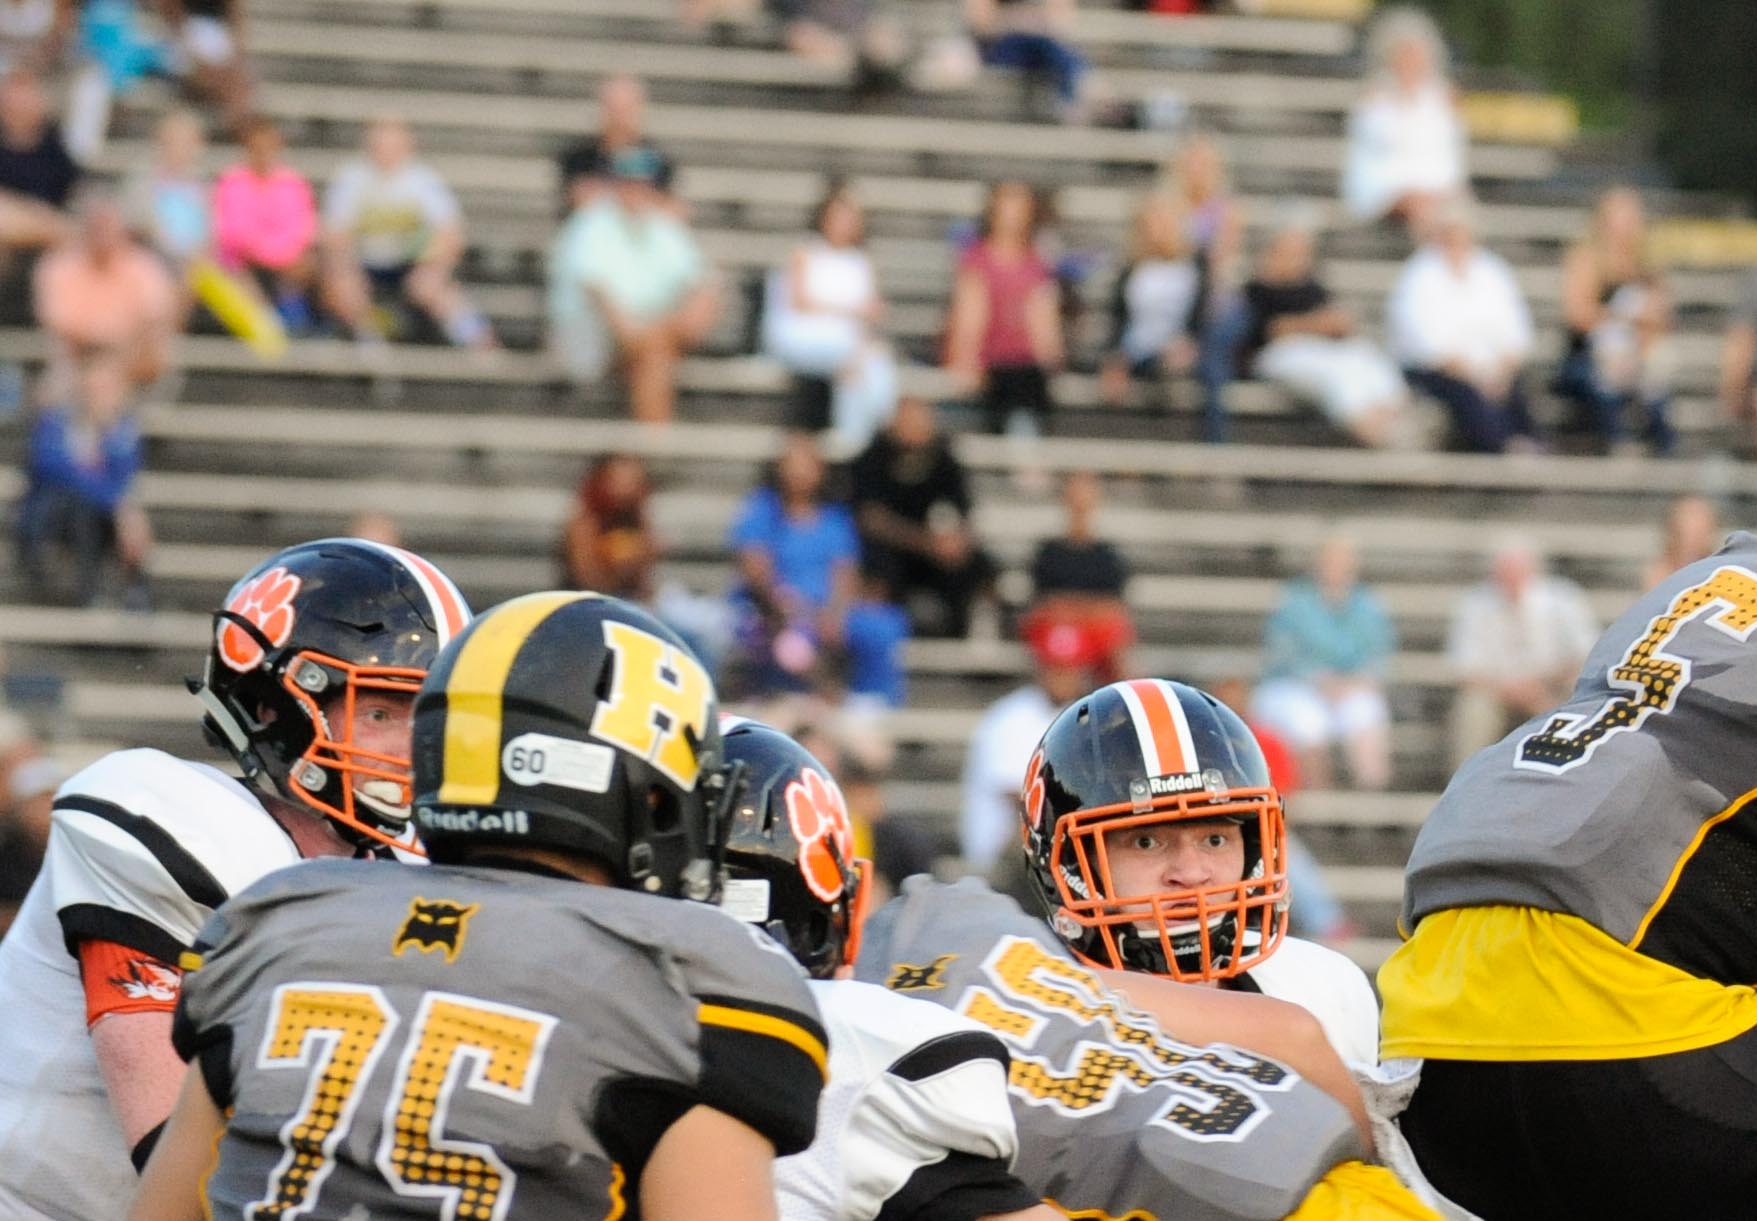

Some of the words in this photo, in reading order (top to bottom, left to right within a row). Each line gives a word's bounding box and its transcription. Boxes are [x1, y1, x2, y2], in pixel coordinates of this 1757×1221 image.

[588, 619, 714, 793] H
[510, 747, 546, 774] 60
[1151, 774, 1203, 794] Riddell
